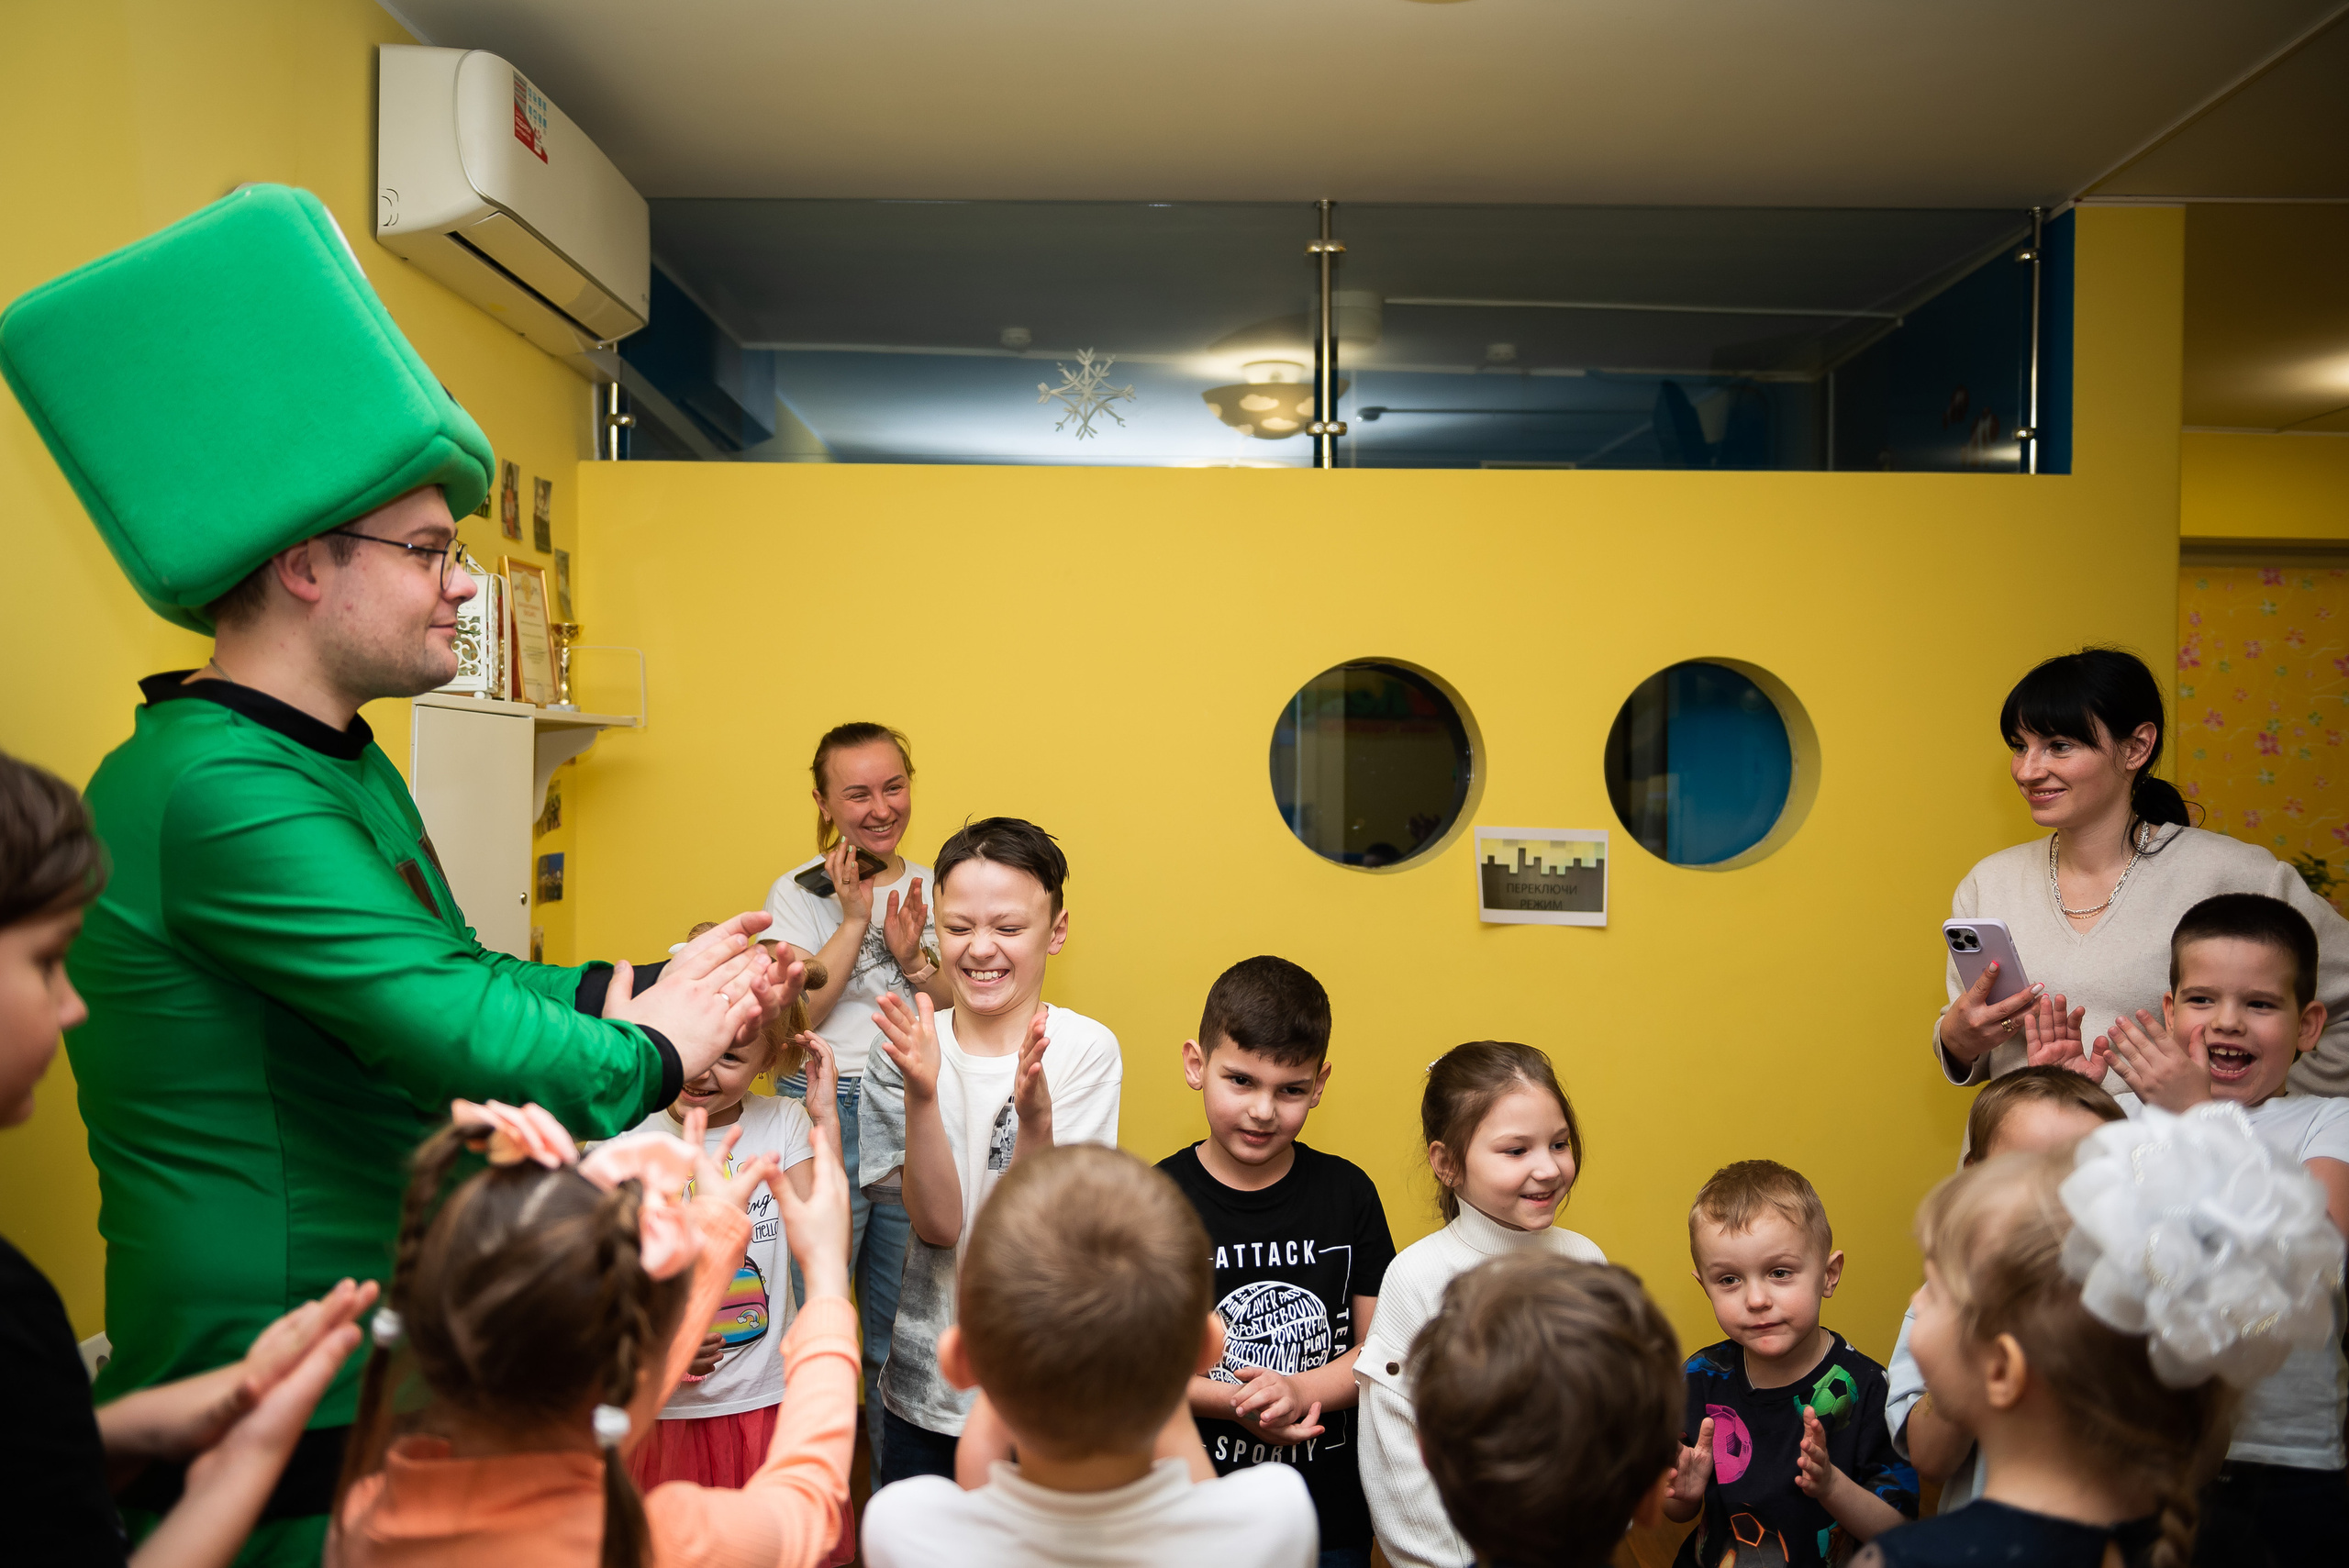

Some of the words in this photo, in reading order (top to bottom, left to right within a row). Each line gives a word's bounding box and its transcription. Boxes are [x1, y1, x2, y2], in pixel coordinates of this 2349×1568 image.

[1507, 883, 1577, 895] ПЕРЕКЛЮЧИ
[1520, 899, 1563, 910] РЕЖИМ
[1216, 1240, 1316, 1269] ATTACK
[1230, 1316, 1264, 1338] SPORT
[1264, 1295, 1327, 1332] REBOUND
[1239, 1289, 1279, 1323] PLAYER
[1277, 1288, 1301, 1304] PASS
[1270, 1318, 1328, 1346] POWERFUL
[1304, 1332, 1327, 1355] PLAY
[1333, 1307, 1350, 1357] TEA
[1223, 1338, 1301, 1374] PROFESSIONAL
[1215, 1435, 1318, 1464] SPORTY
